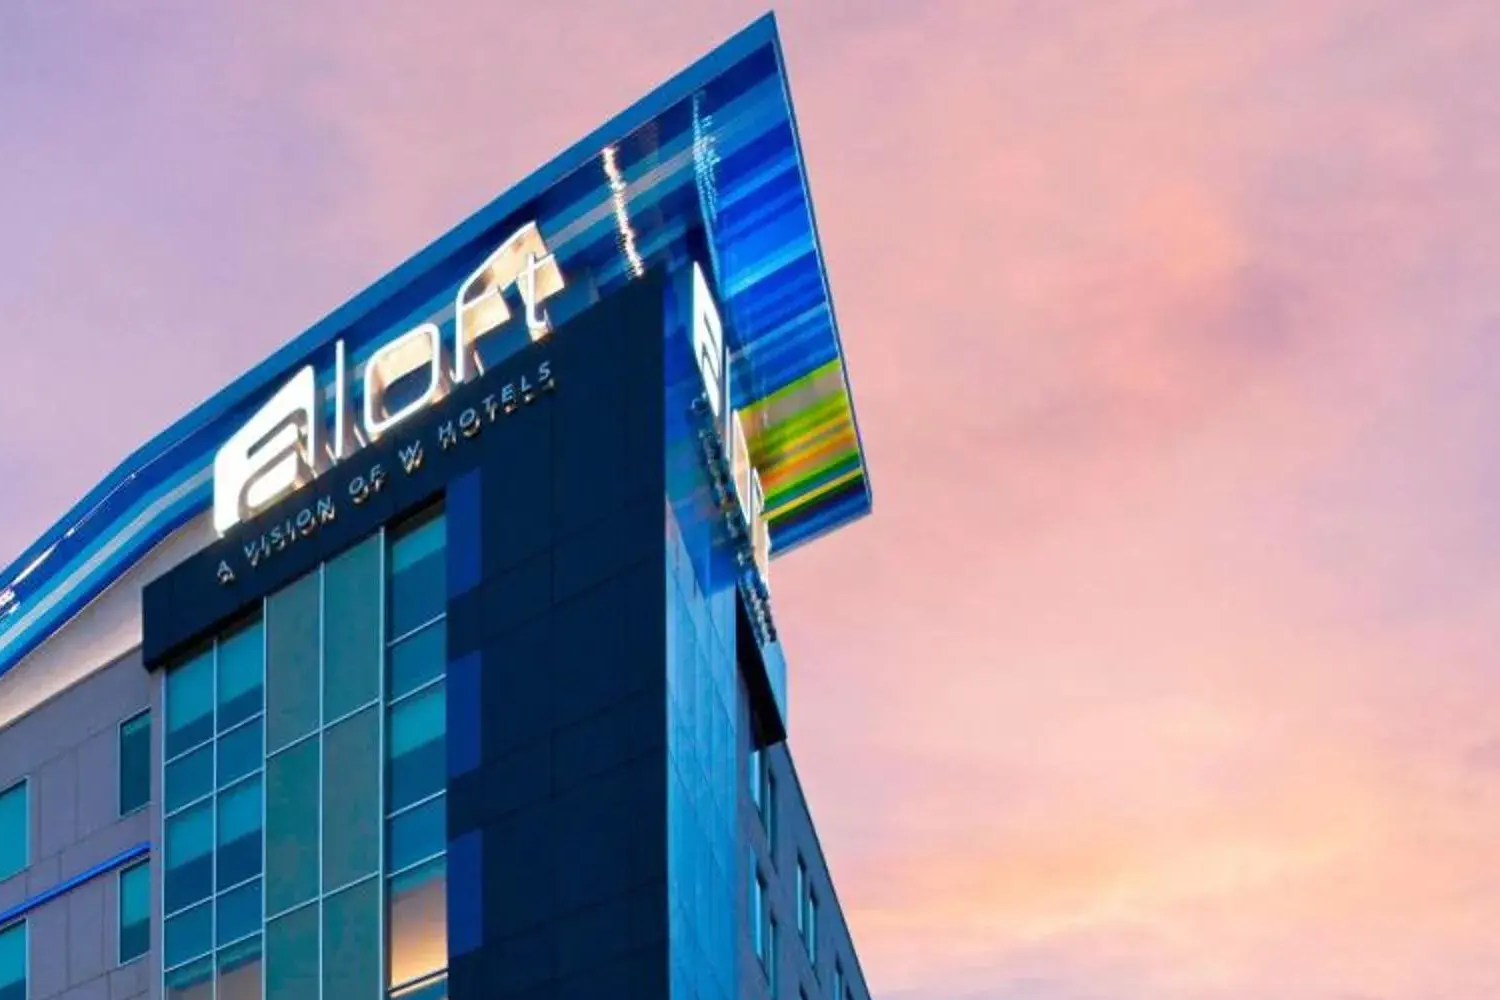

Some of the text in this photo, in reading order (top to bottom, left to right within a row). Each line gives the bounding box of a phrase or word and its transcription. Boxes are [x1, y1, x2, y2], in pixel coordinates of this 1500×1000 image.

[213, 221, 558, 537] aloft
[244, 496, 333, 562] VISION
[349, 464, 383, 499] OF
[398, 440, 422, 471] W
[438, 361, 553, 446] HOTELS
